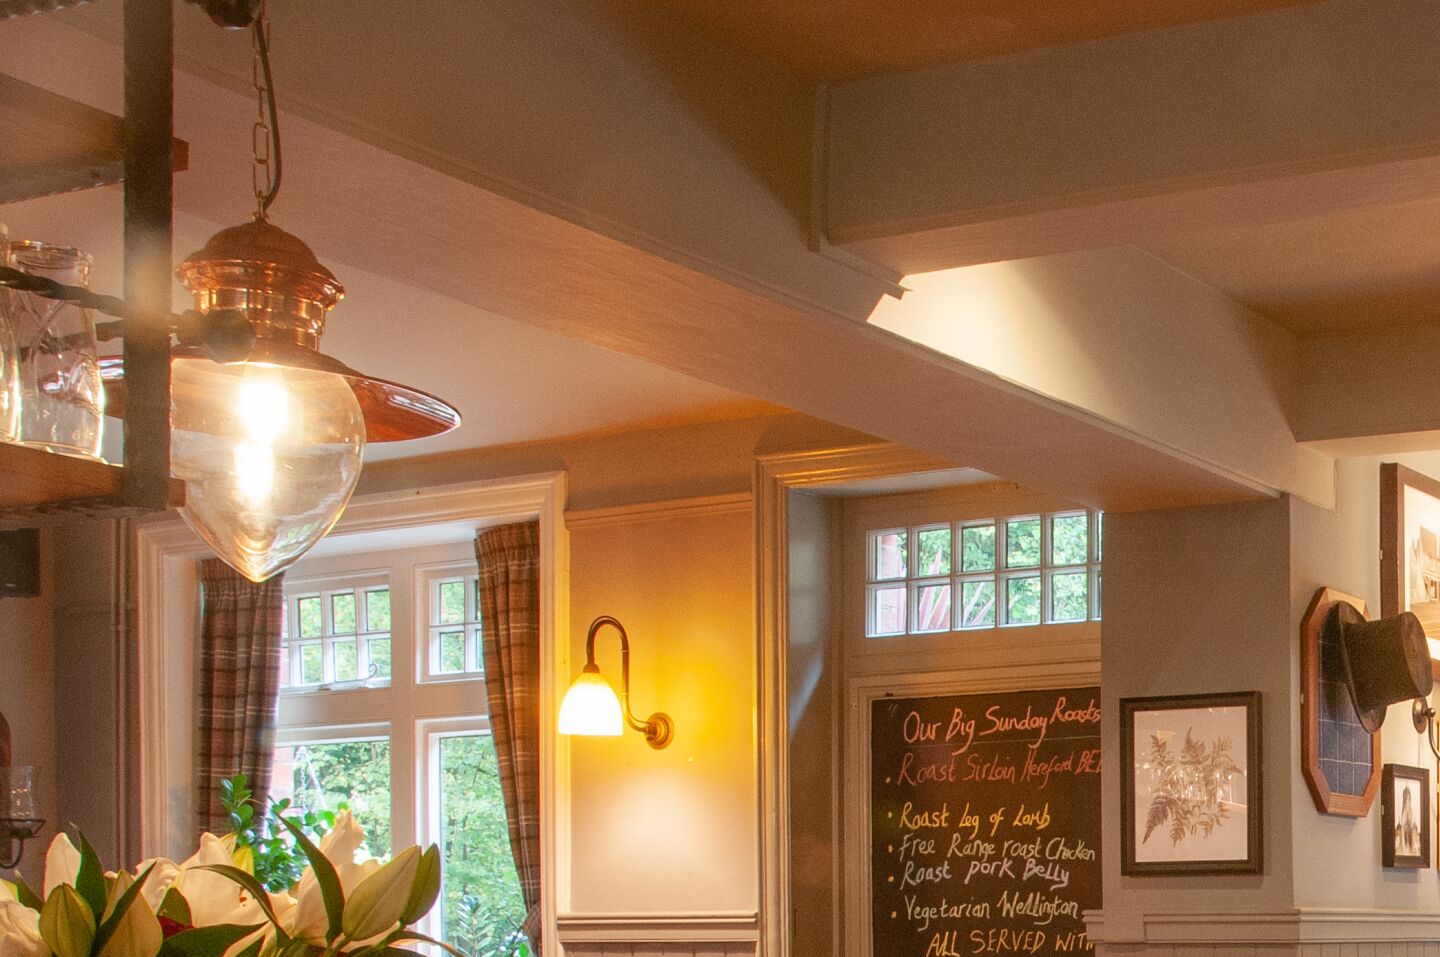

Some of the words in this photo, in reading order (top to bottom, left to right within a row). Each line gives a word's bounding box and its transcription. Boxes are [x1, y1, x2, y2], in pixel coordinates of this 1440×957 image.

[903, 711, 942, 743] Our
[945, 707, 976, 756] Big
[979, 705, 1048, 748] Sunday
[1050, 696, 1101, 723] Roasts
[897, 752, 957, 787] Roast
[1021, 748, 1073, 790] Hereford
[899, 801, 949, 830] Roast
[958, 802, 980, 839] Leg
[989, 807, 1005, 837] of
[1013, 803, 1051, 830] Lamb
[900, 832, 936, 862] Free
[947, 832, 996, 862] Range
[1001, 836, 1042, 860] roast
[1045, 837, 1096, 862] Chicken
[900, 860, 952, 890] Roast
[904, 895, 990, 932] Vegetarian
[925, 930, 961, 957] ALL
[970, 928, 1046, 954] SERVED
